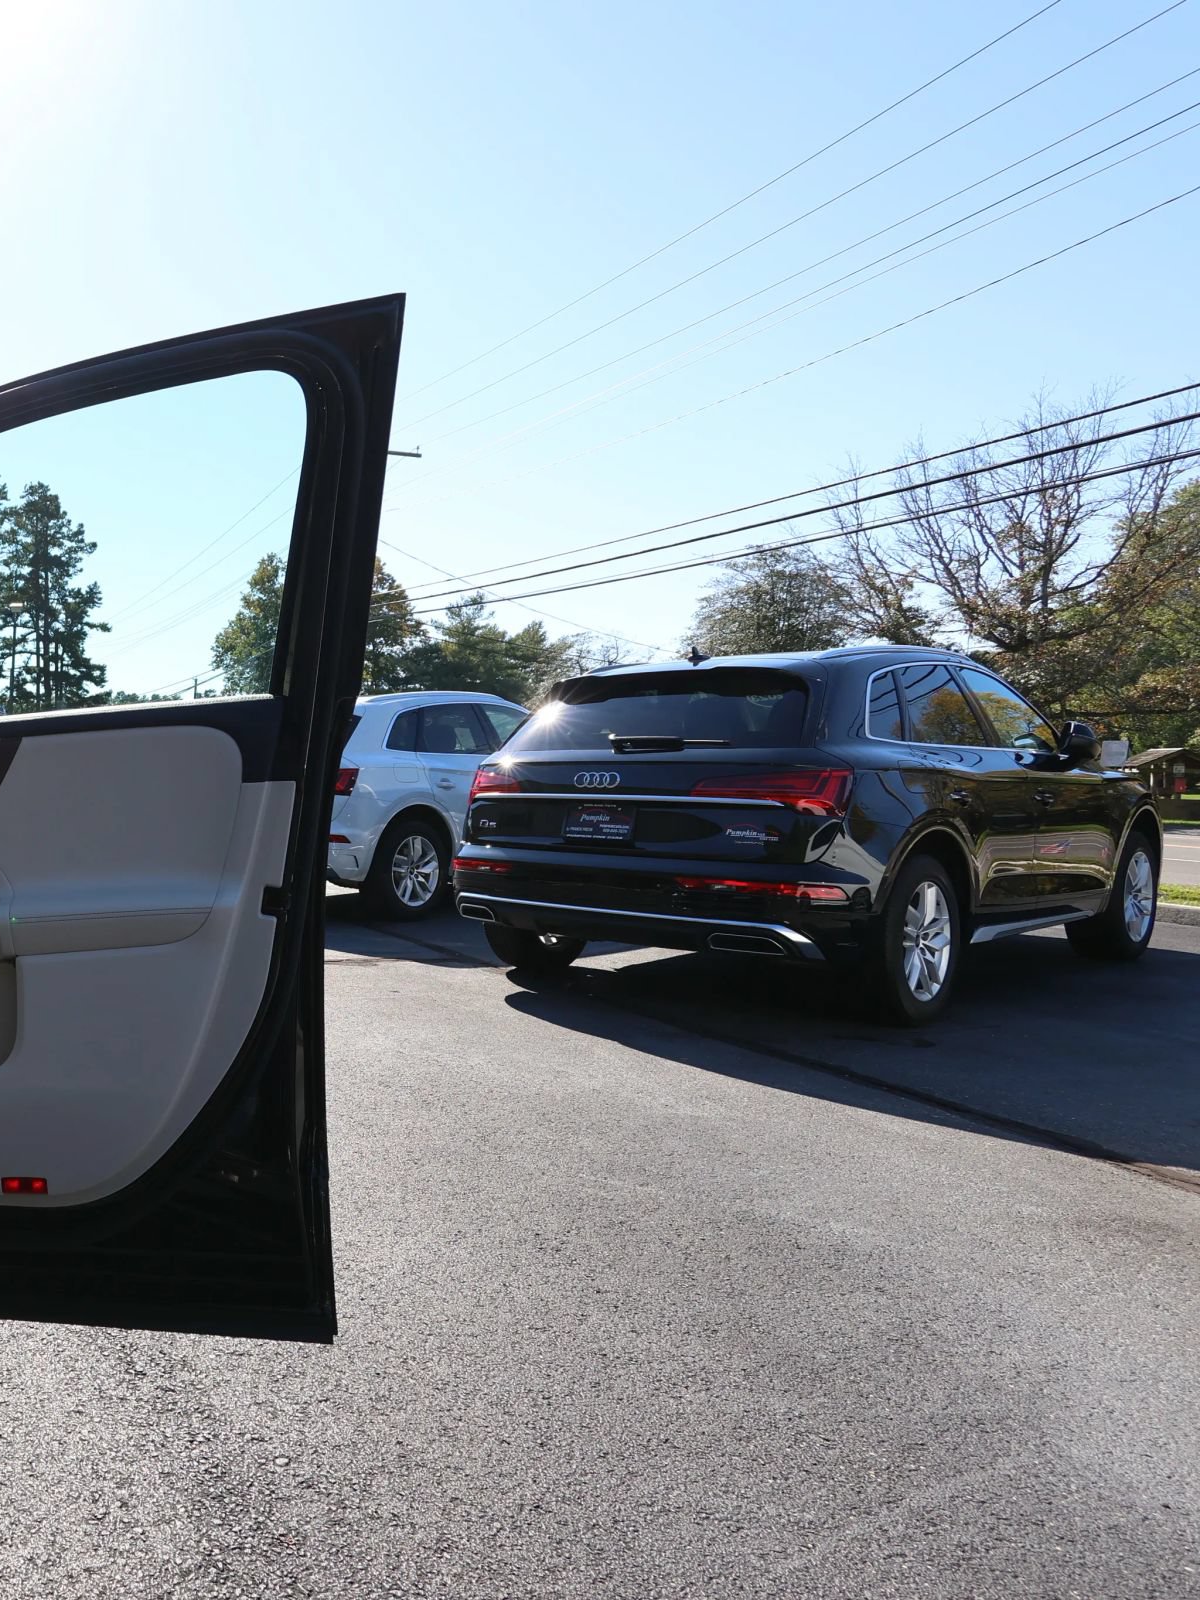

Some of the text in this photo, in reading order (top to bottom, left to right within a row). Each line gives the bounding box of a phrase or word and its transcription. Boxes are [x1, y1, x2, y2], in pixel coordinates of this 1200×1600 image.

[580, 814, 610, 823] Pumpkin
[479, 819, 497, 828] Q5
[725, 828, 758, 837] Pumpkin
